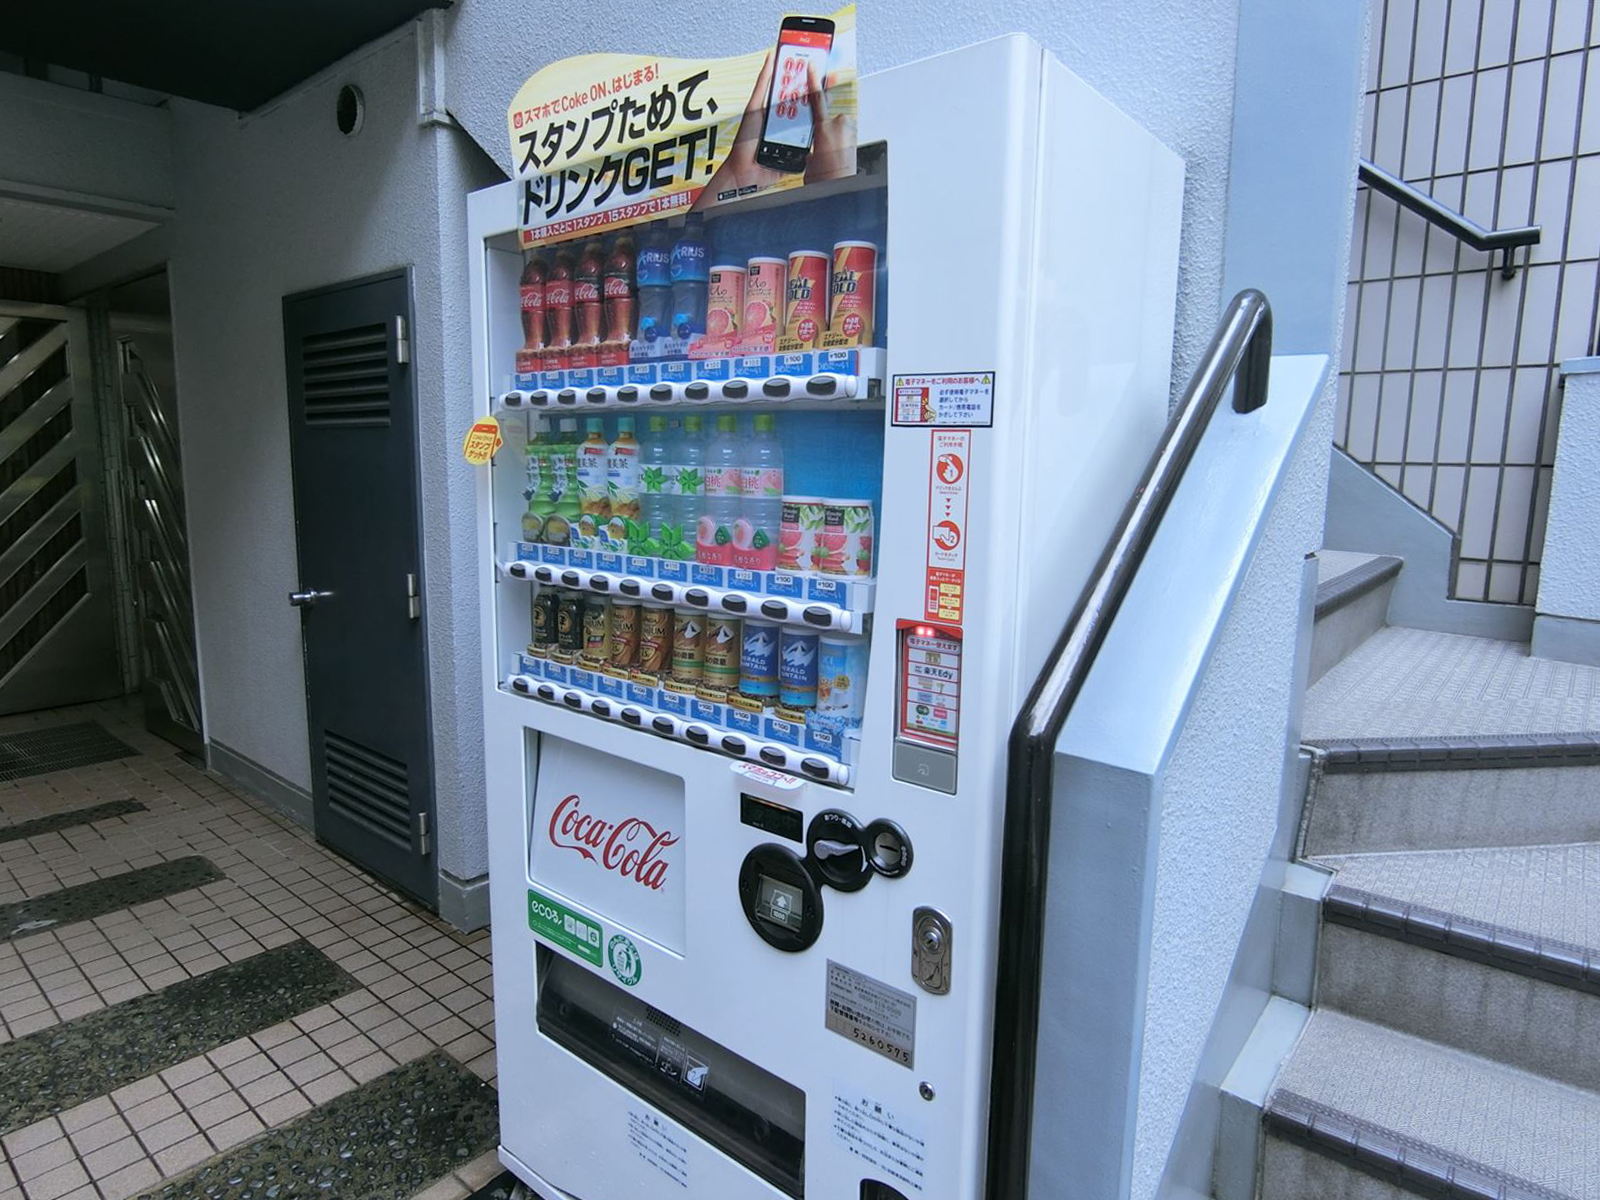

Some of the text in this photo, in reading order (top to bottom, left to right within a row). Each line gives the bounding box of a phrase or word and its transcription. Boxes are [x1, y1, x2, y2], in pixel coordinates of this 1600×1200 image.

[519, 70, 718, 174] スタンプためて、
[853, 1027, 910, 1062] 5260575
